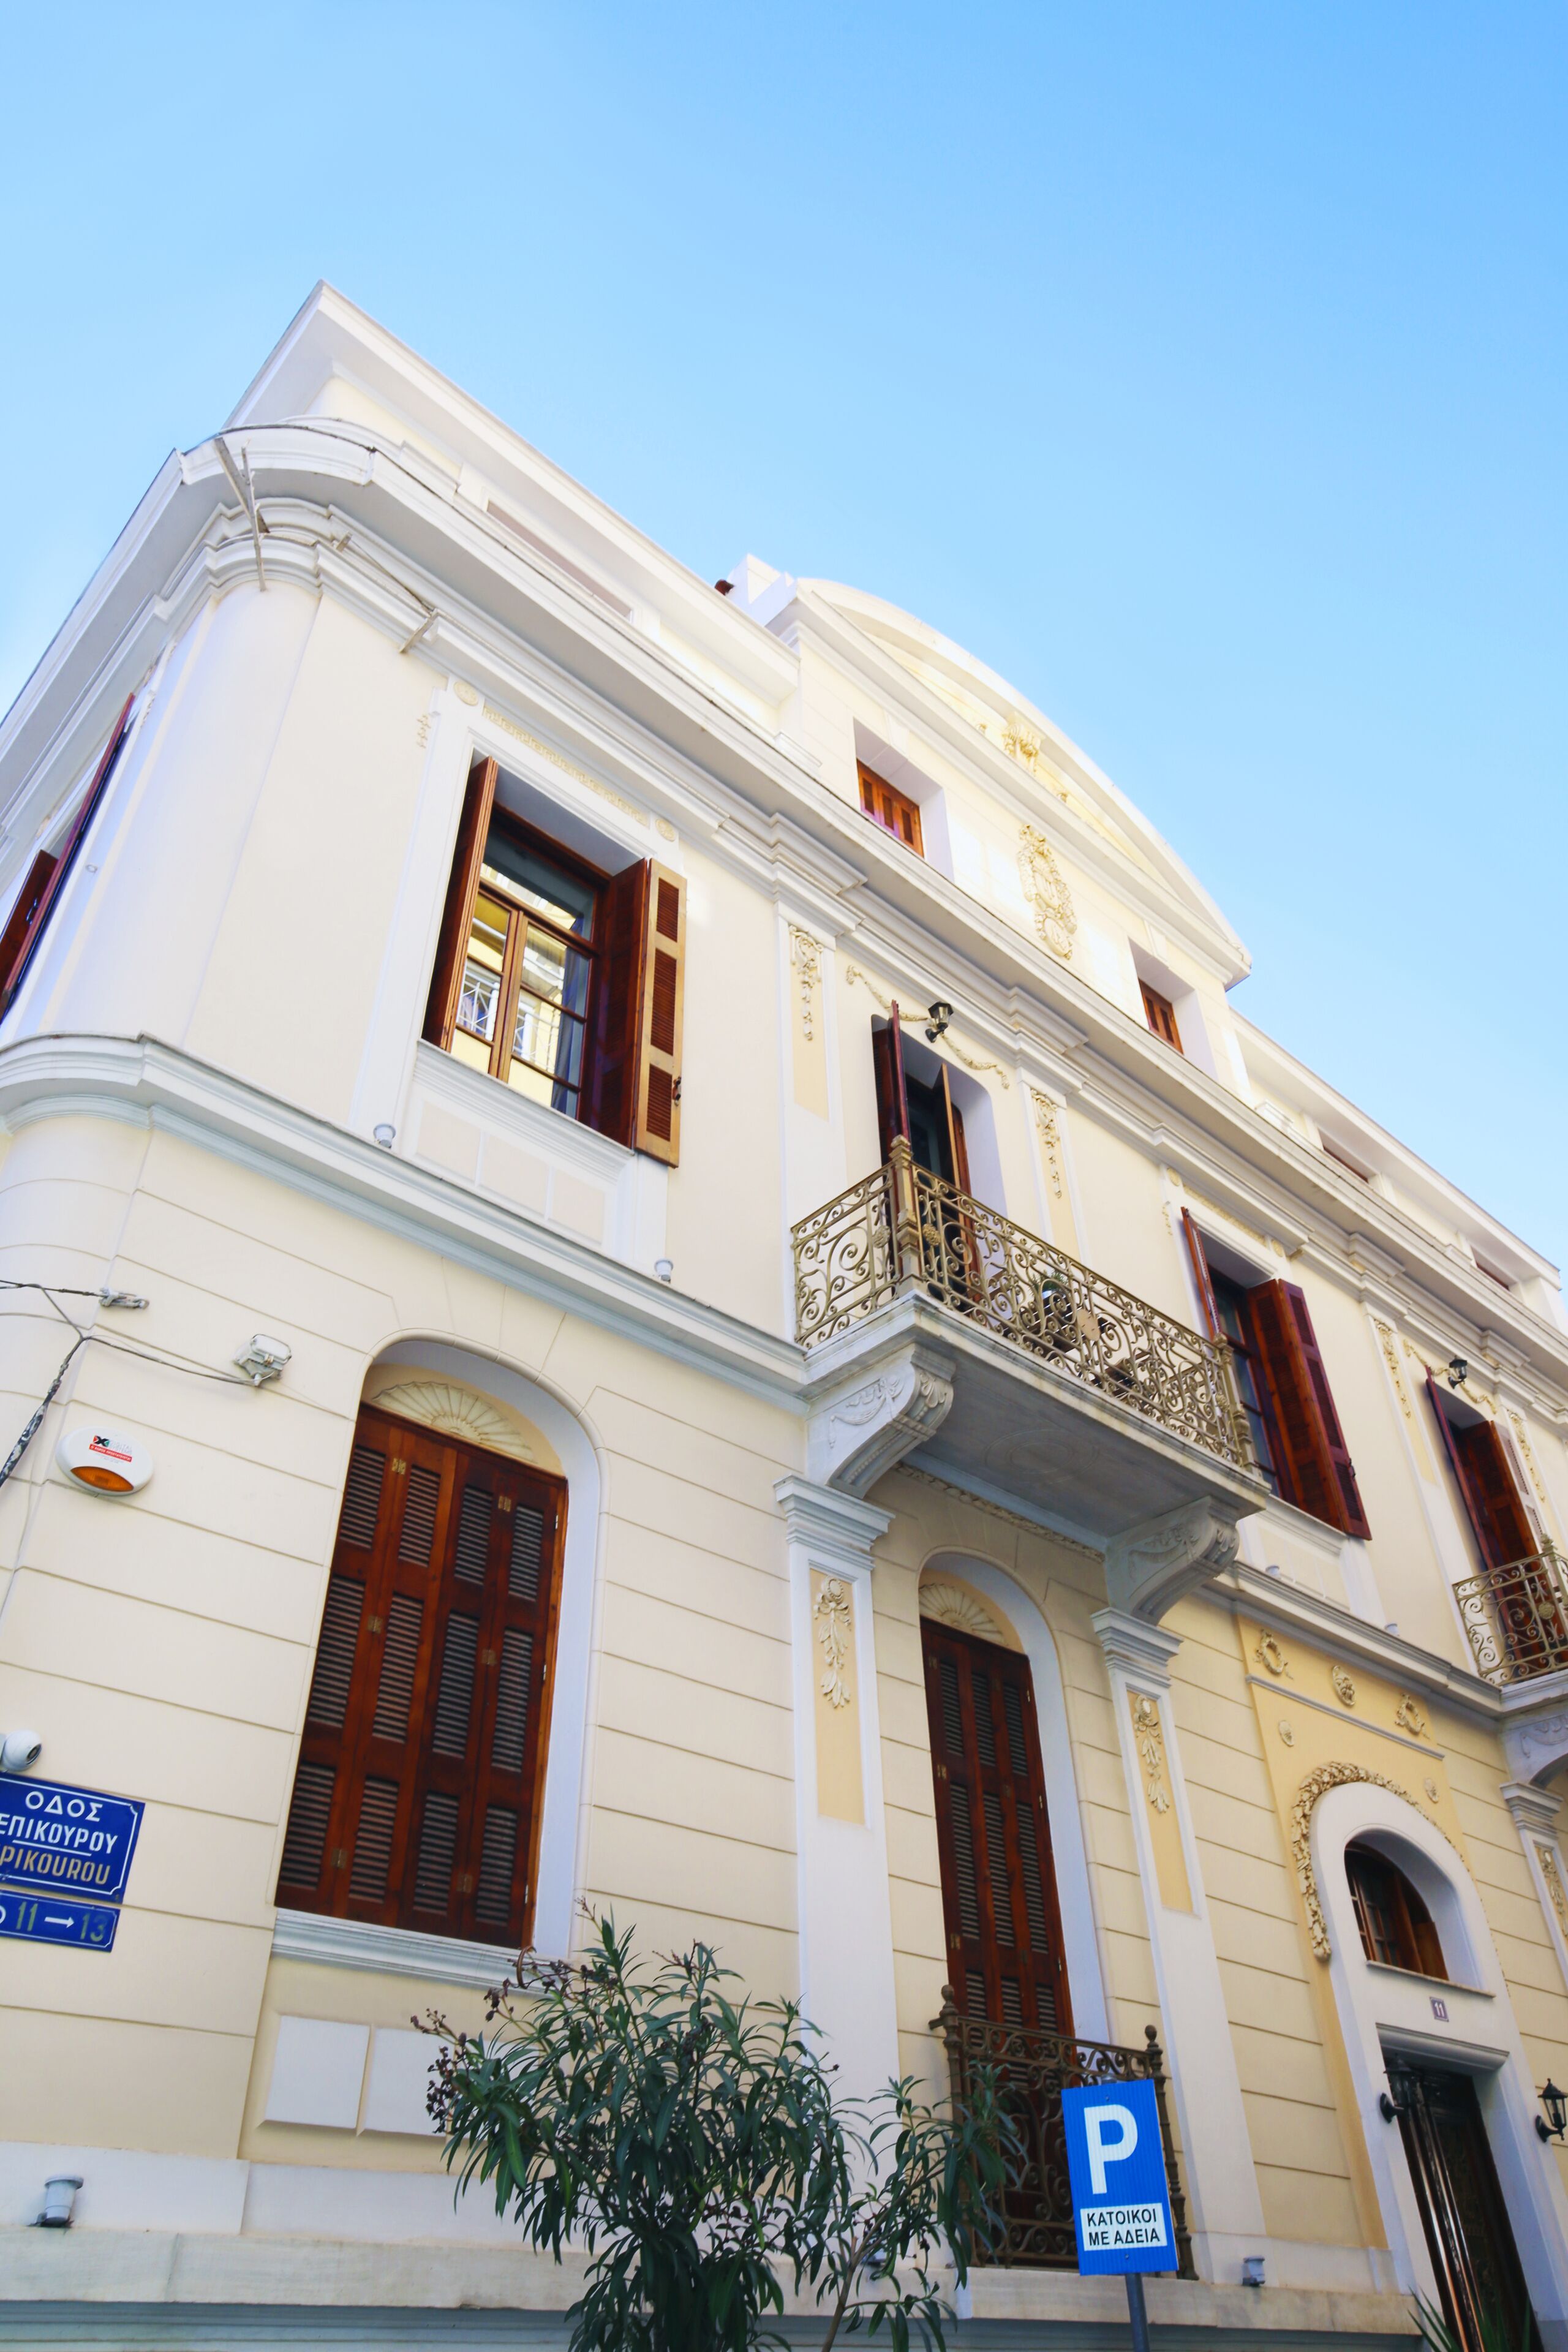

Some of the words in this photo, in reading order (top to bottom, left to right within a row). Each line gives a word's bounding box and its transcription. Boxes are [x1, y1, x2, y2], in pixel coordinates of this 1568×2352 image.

[25, 1790, 103, 1822] ΟΔΟΣ
[0, 1845, 111, 1885] PIKOUROU
[16, 1901, 38, 1932] 11
[80, 1912, 107, 1942] 13
[1434, 2002, 1445, 2018] 11
[1084, 2104, 1138, 2195] P
[1087, 2207, 1157, 2228] ΚΑΤΟΙΚΟΙ
[1088, 2231, 1110, 2247] ΜΕ
[1114, 2228, 1161, 2245] ΑΔΕΙΑ
